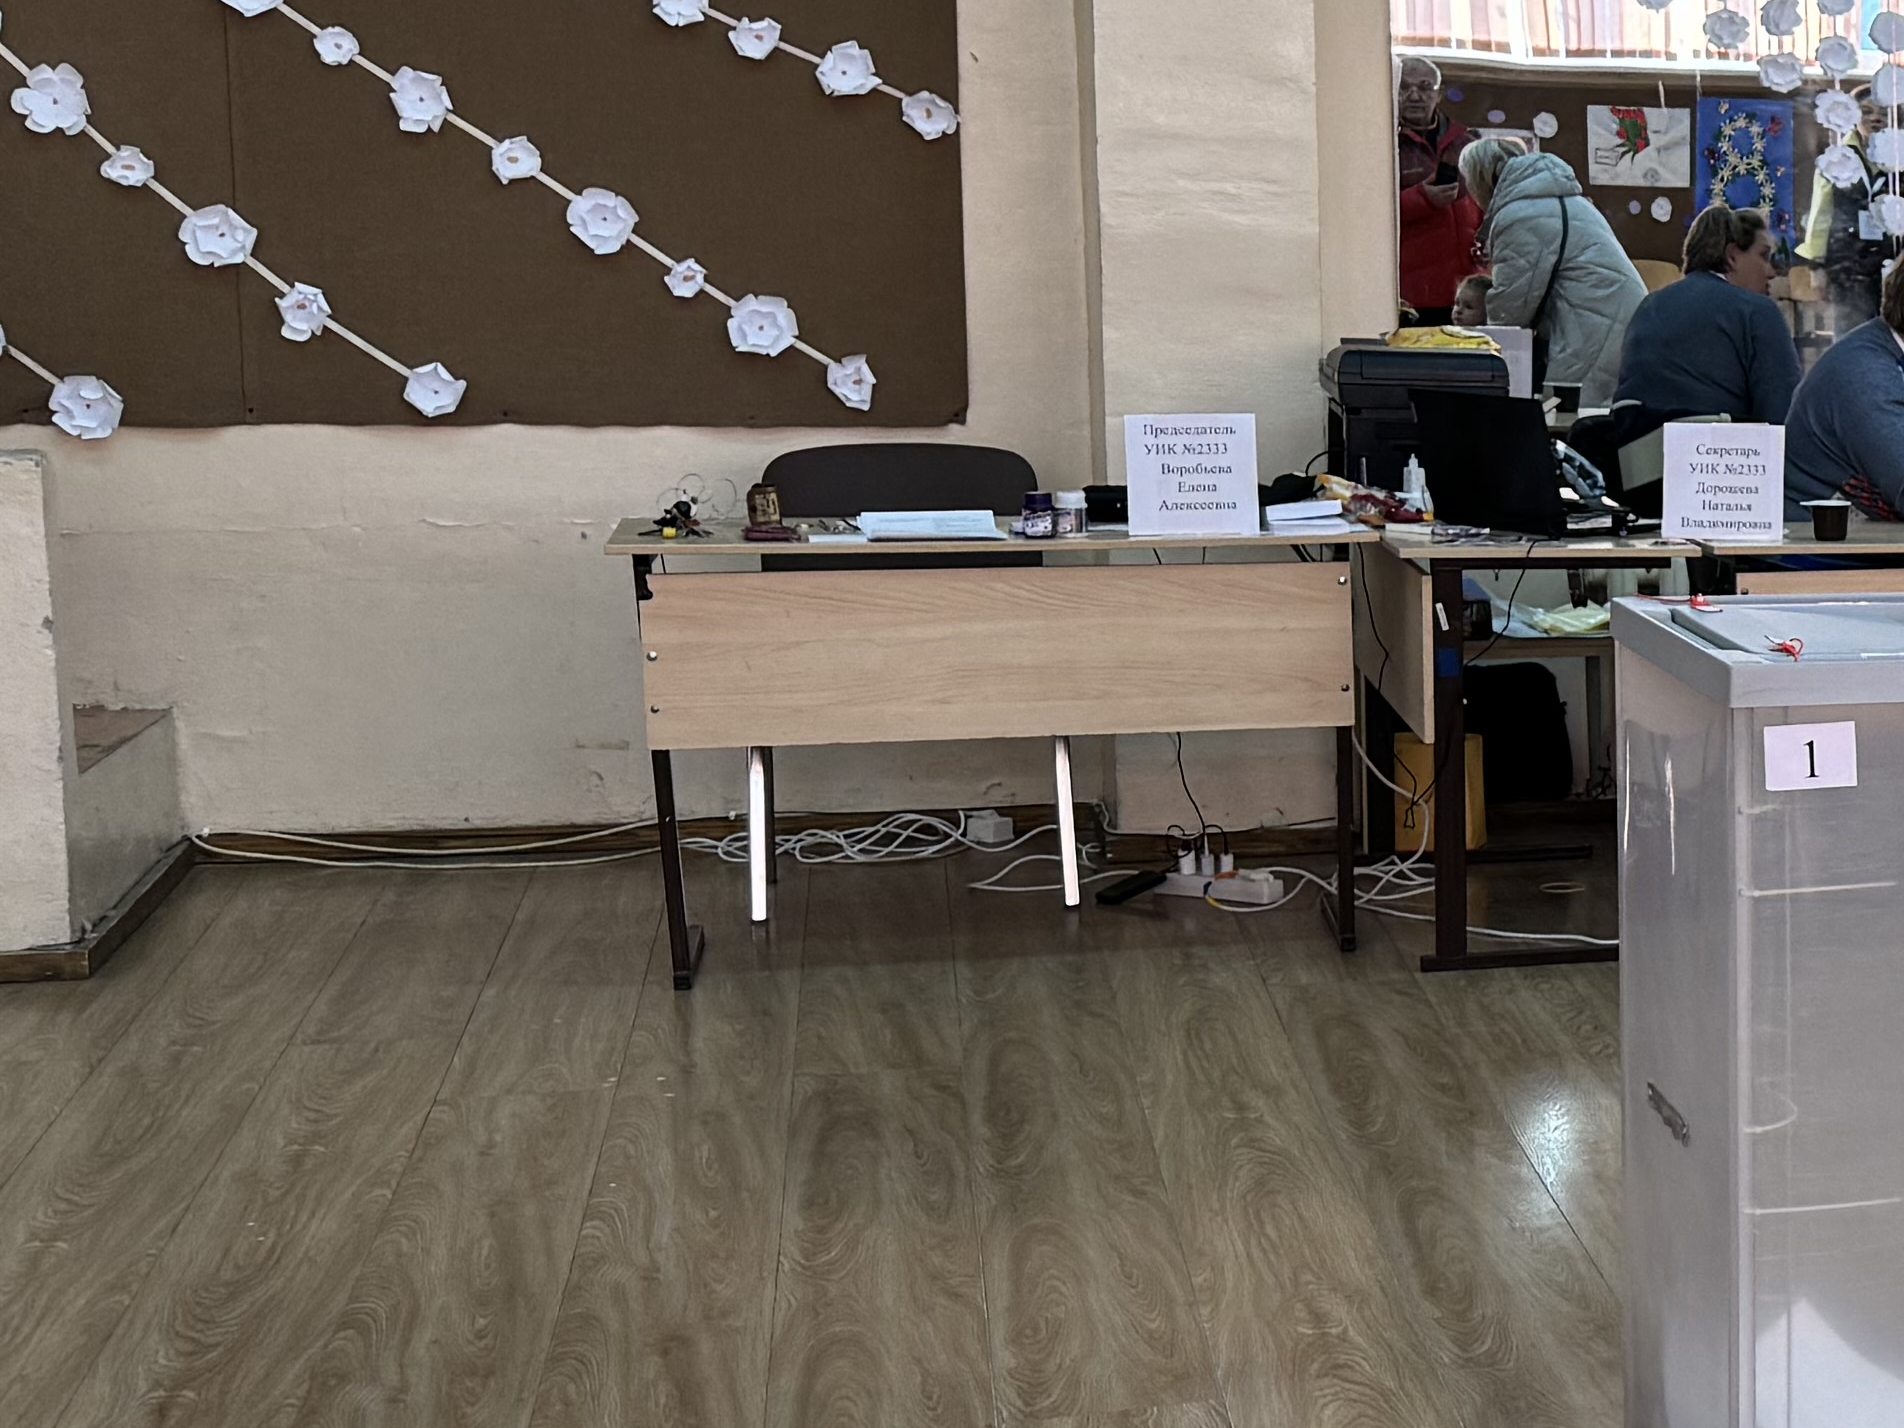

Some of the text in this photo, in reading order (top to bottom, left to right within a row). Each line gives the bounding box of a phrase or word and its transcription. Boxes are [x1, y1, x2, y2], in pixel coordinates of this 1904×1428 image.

[1143, 424, 1237, 439] Председатель
[1143, 443, 1178, 455] УИК
[1696, 443, 1761, 458] Секретарь
[1161, 462, 1233, 477] Воробьева
[1689, 462, 1720, 475] УИК
[1178, 481, 1217, 493] Елена
[1158, 499, 1238, 512] Алексеевна
[1702, 499, 1753, 512] Наталья
[1681, 516, 1773, 531] Владимировна
[1803, 739, 1820, 779] 1
